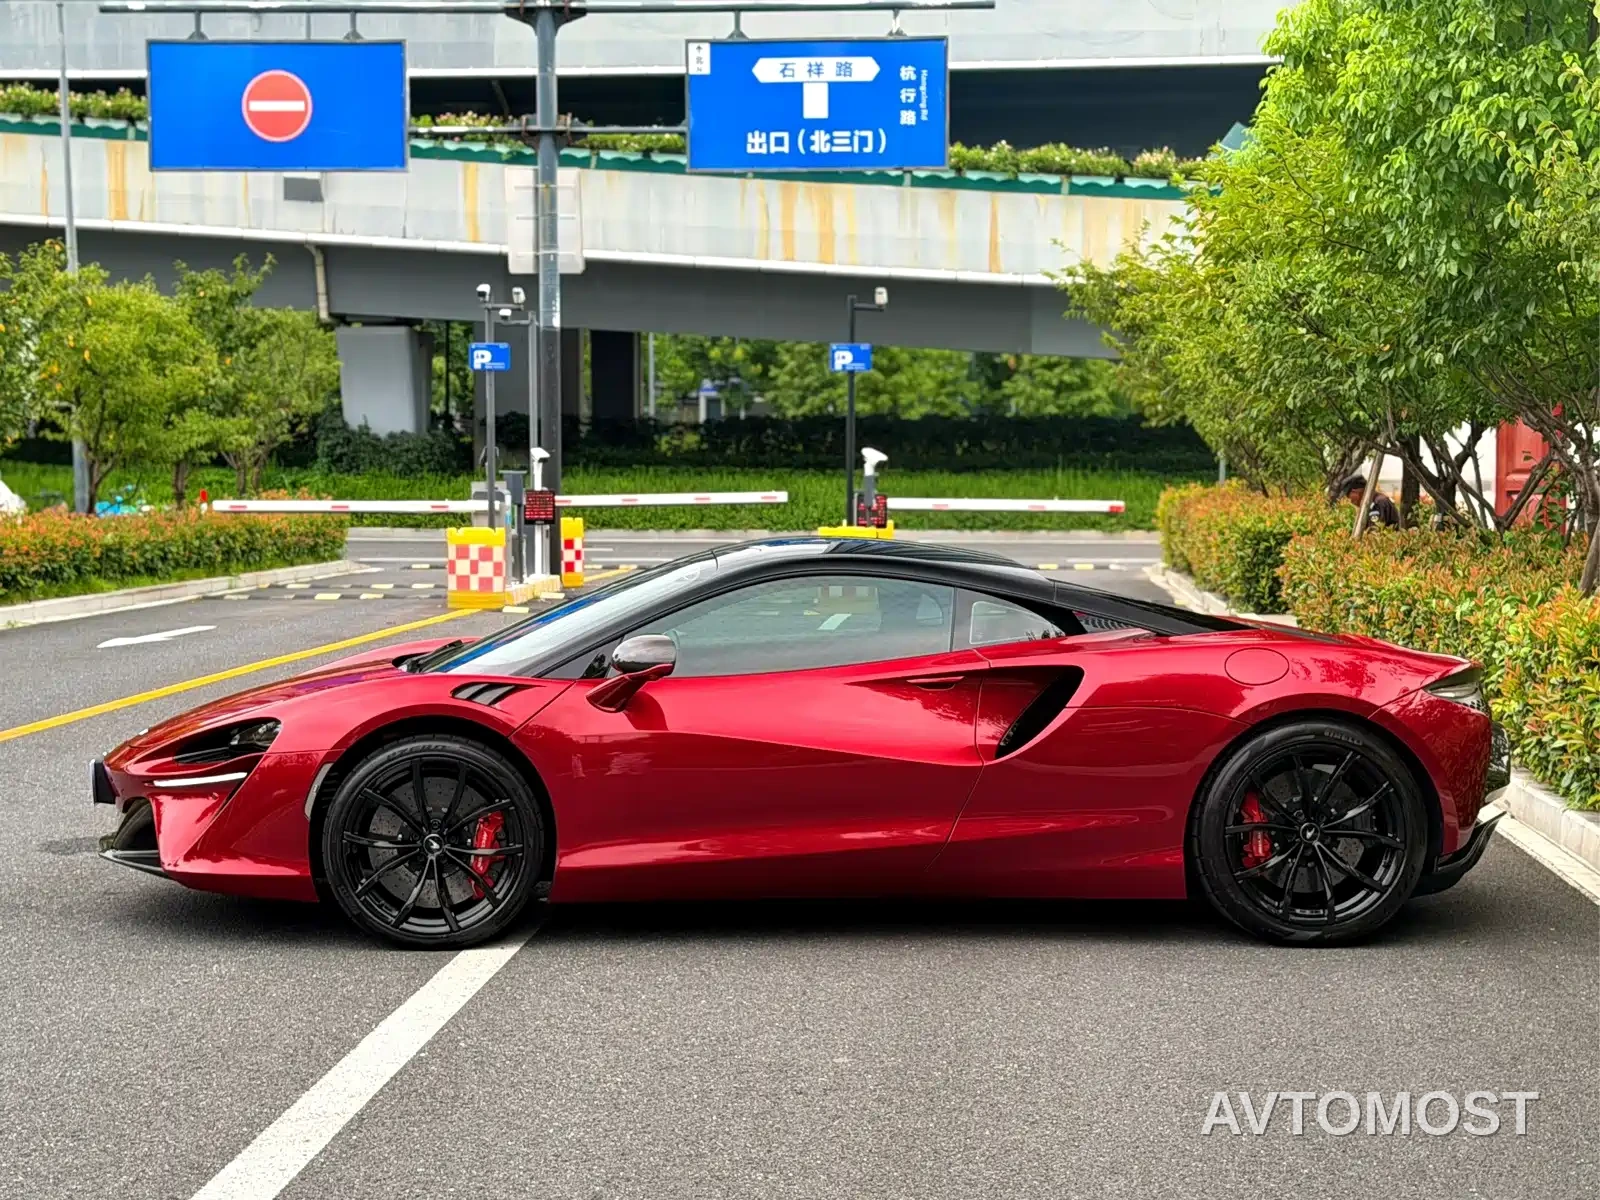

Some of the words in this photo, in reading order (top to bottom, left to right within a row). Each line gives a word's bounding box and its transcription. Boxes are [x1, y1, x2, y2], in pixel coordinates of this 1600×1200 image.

[779, 61, 853, 79] 石祥路
[900, 65, 917, 126] 杭行路
